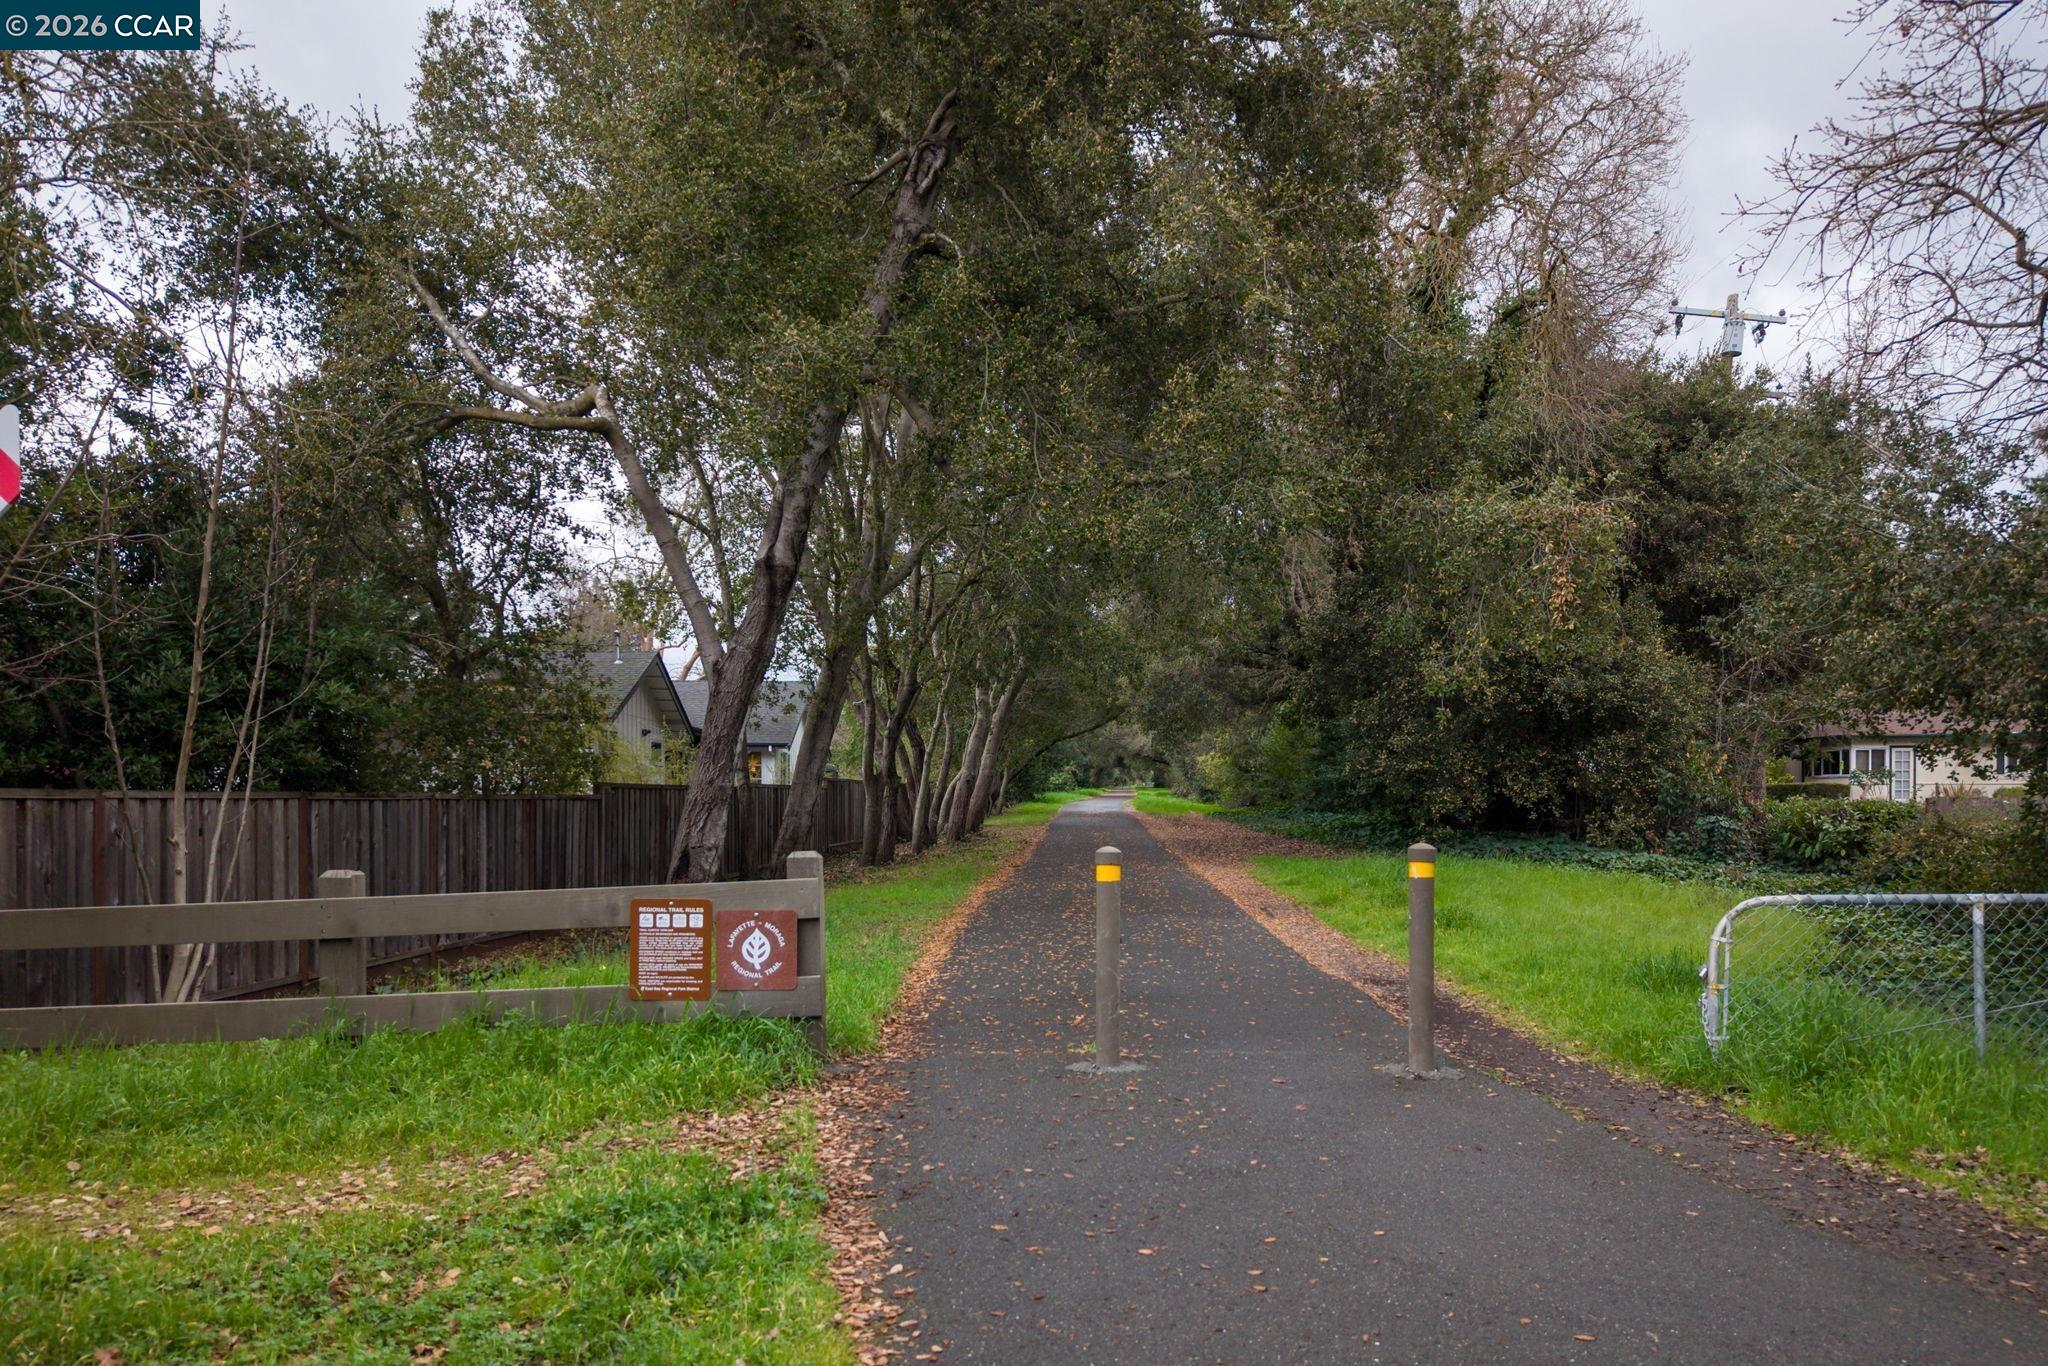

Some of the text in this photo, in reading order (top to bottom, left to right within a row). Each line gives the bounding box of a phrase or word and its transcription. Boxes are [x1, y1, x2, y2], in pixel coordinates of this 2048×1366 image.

[727, 920, 756, 948] LAFAYETTE
[764, 921, 786, 947] MORAGA
[730, 960, 783, 978] REGIONAL TRAIL
